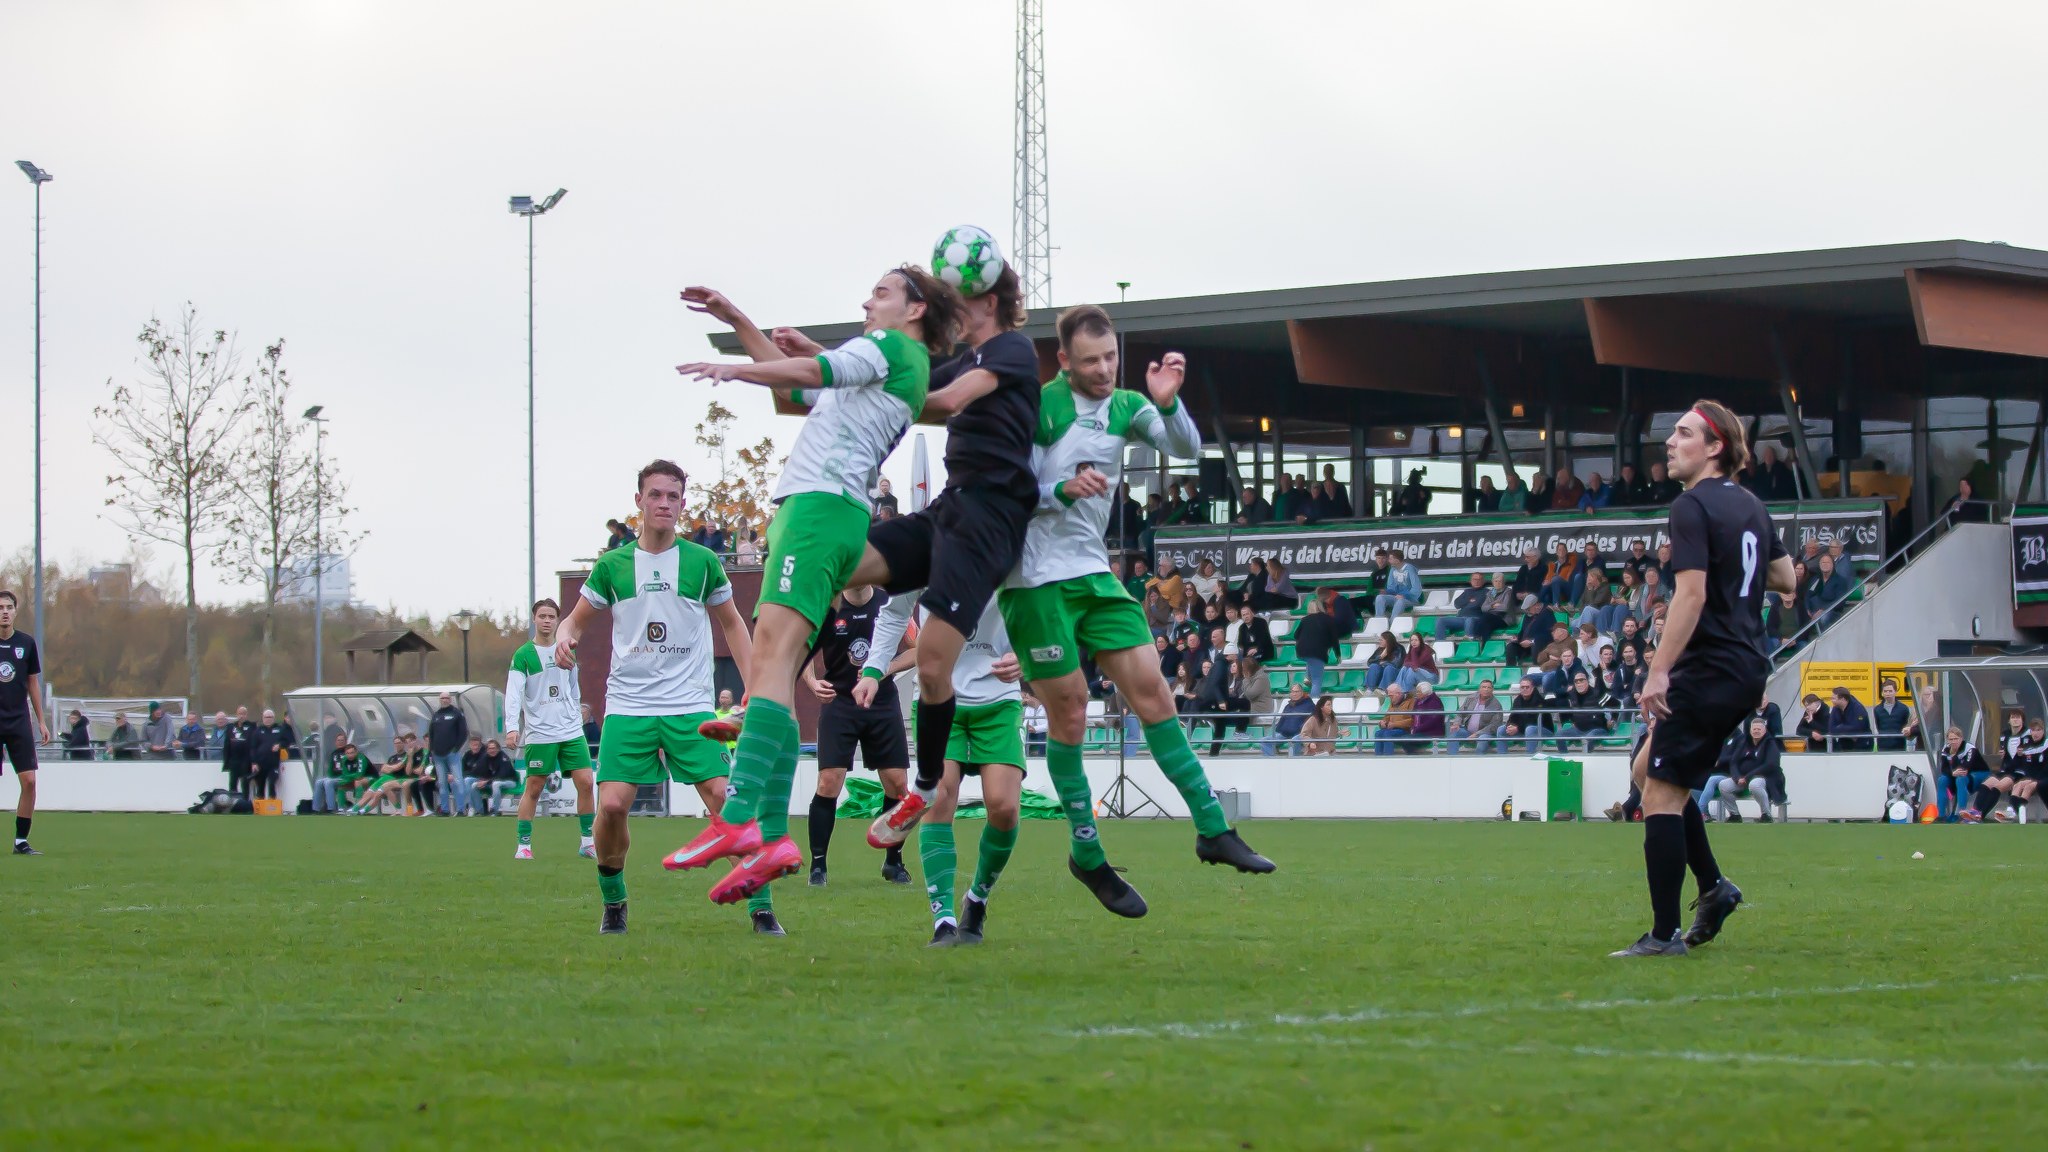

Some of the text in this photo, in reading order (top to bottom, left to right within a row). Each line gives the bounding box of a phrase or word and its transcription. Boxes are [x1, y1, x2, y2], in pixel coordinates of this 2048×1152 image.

[1280, 546, 1293, 564] is
[1296, 545, 1322, 564] dat
[1428, 540, 1443, 559] is
[1446, 539, 1473, 559] dat
[782, 555, 796, 577] 5
[1739, 531, 1758, 597] 9
[659, 643, 691, 654] Oviron
